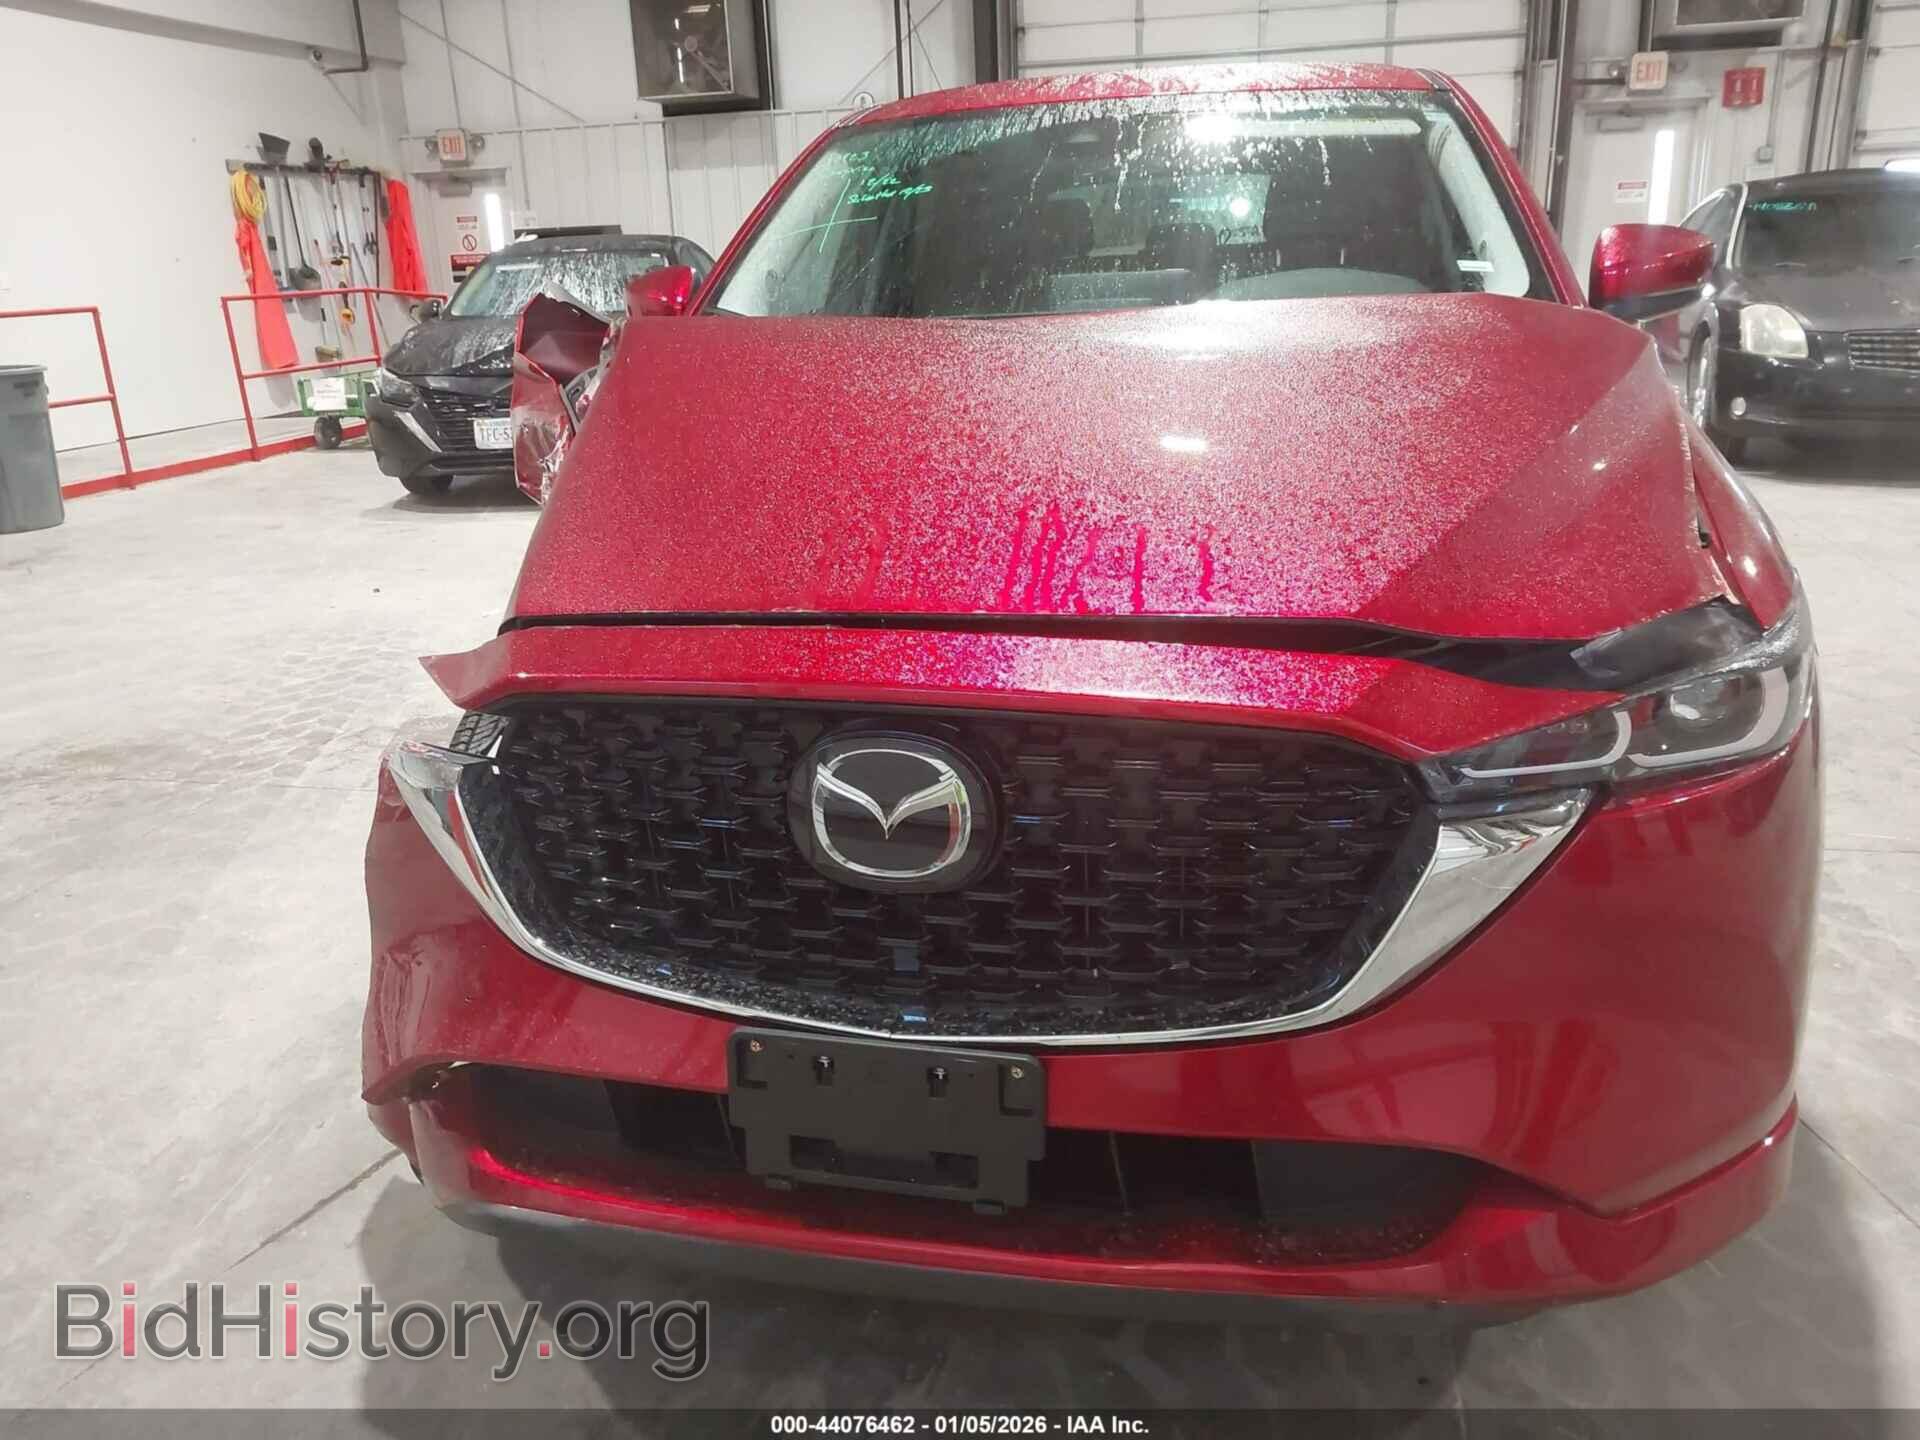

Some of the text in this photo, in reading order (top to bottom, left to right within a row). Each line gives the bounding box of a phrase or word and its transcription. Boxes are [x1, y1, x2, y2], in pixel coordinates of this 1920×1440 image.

[1636, 61, 1663, 81] EXIT
[442, 135, 462, 153] EXIT
[480, 427, 512, 440] TFC-5
